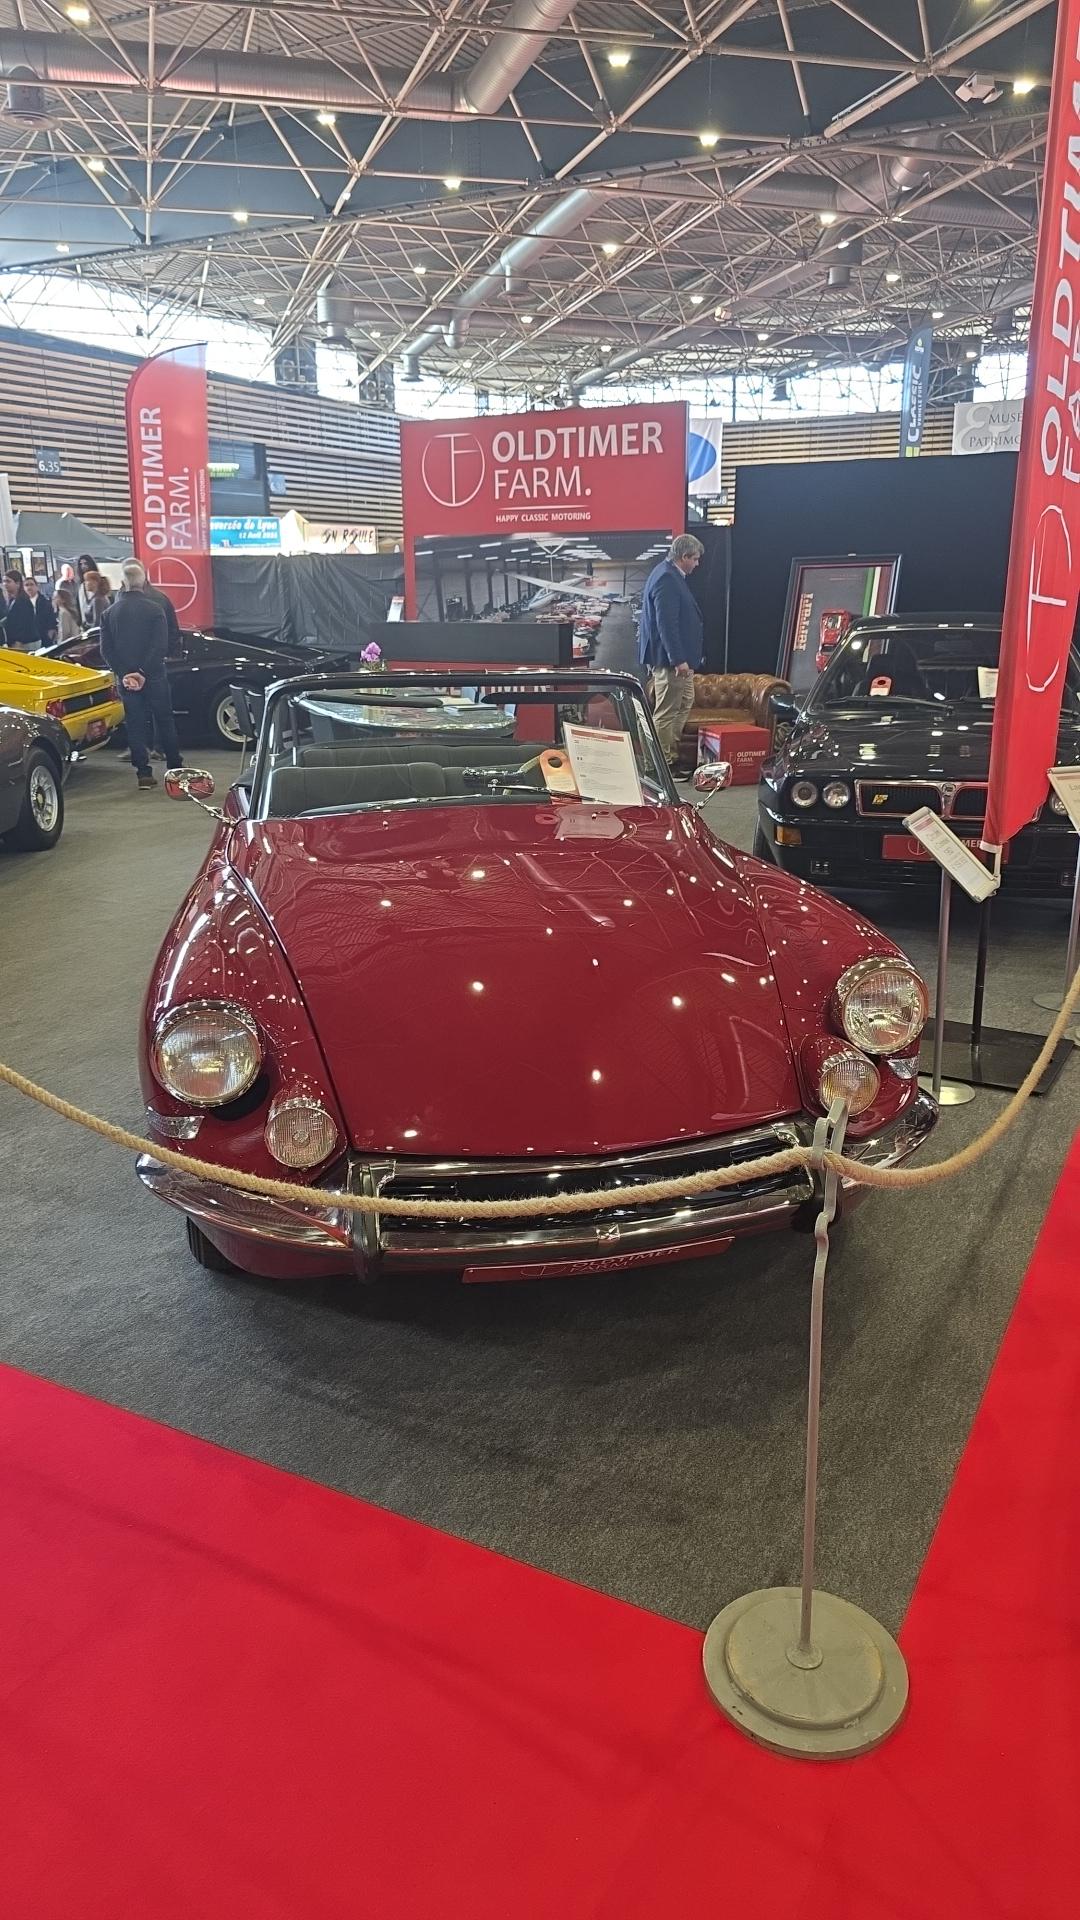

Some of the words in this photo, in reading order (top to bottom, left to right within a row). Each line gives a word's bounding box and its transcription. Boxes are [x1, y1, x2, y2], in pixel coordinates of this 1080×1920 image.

[492, 421, 663, 463] OLDTIMER
[38, 460, 60, 473] 6.35
[139, 407, 167, 551] OLDTIMER
[494, 465, 592, 500] FARM.
[168, 467, 193, 550] FARM.
[496, 514, 519, 523] HAPPY
[521, 513, 549, 522] CLASSIC
[551, 512, 592, 521] MOTORING
[244, 518, 255, 530] de
[257, 519, 278, 532] Lyon
[320, 528, 338, 544] ON
[343, 528, 374, 544] ROULE
[793, 593, 813, 651] Ferrari
[736, 750, 766, 758] OLDTIMER
[573, 1249, 680, 1268] OLDTIMER
